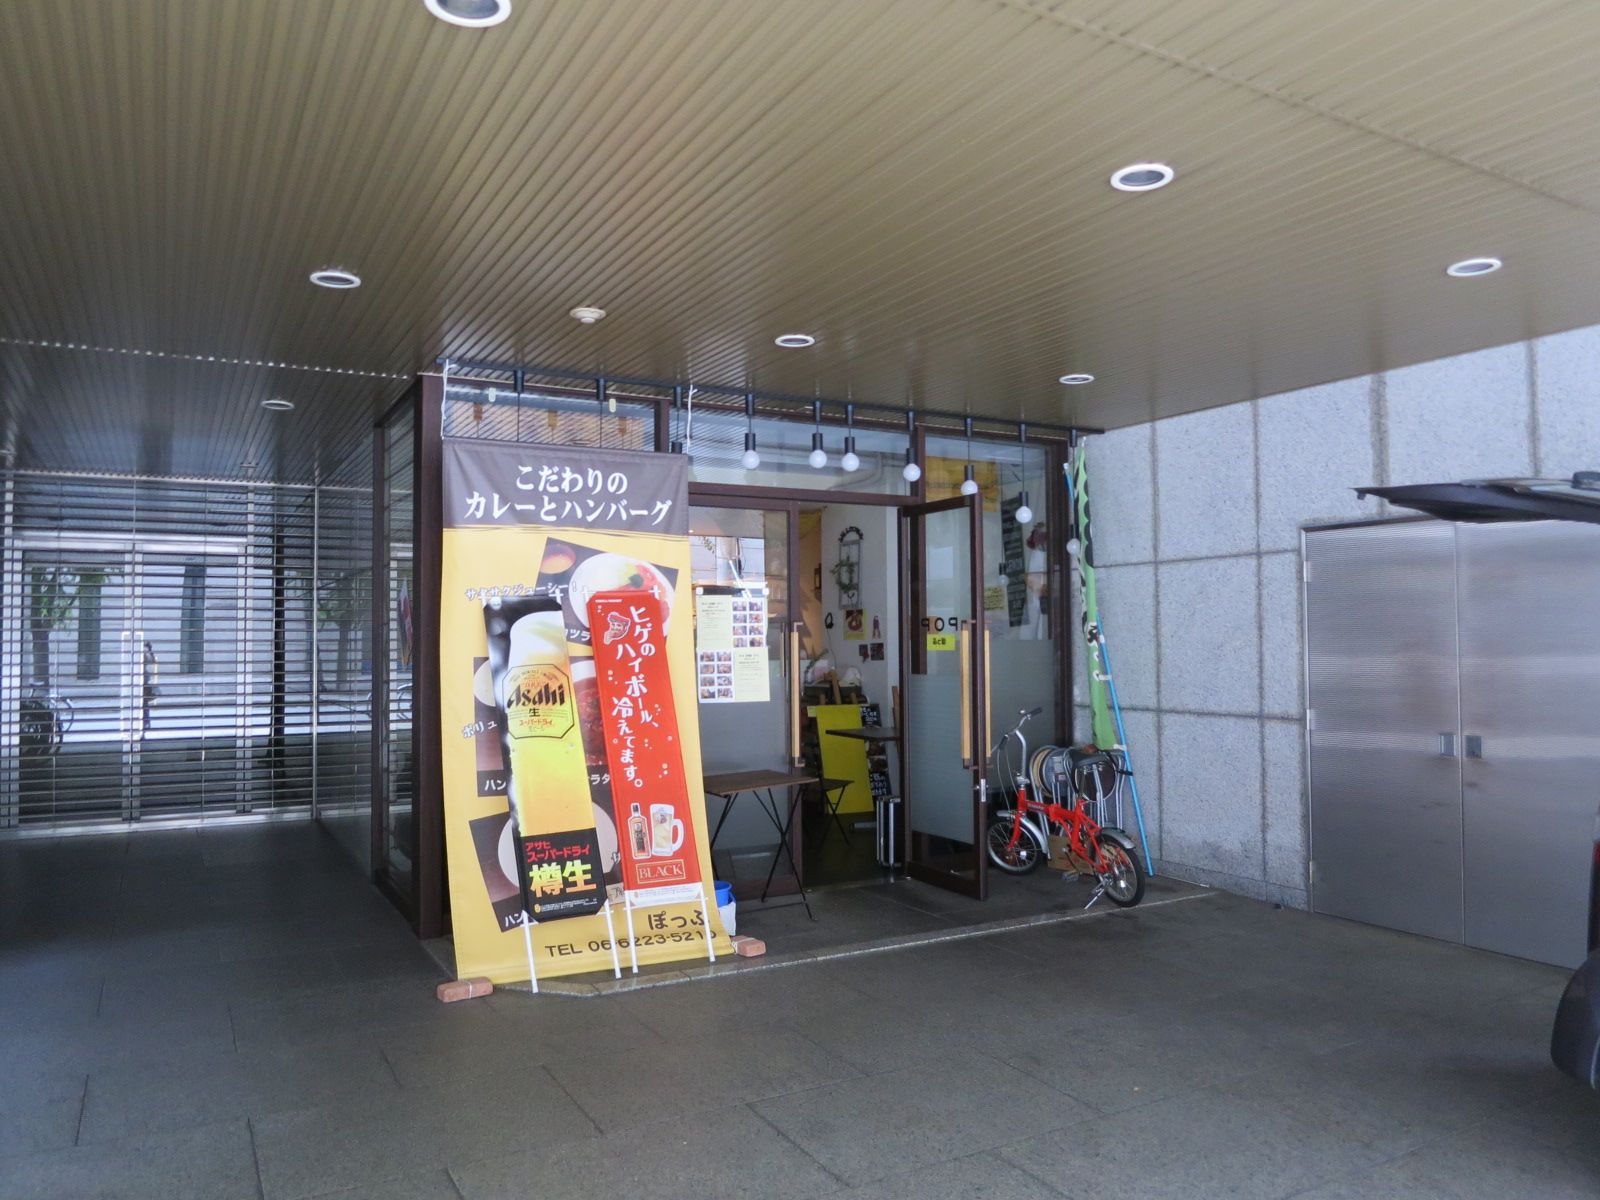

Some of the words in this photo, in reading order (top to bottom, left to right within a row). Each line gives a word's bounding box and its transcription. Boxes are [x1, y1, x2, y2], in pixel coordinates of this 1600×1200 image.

[516, 464, 628, 495] こだわりの
[463, 491, 673, 526] カレーとハンバーグ
[565, 628, 591, 642] ツラ
[629, 605, 656, 657] ヒゲの
[507, 683, 565, 709] Asahi
[528, 707, 541, 718] 生
[611, 696, 643, 788] 冷えてます。
[484, 779, 507, 791] ハン
[587, 772, 610, 785] ラタ
[526, 840, 552, 852] アサヒ
[527, 844, 591, 863] スーパードライ
[529, 859, 597, 898] 樽生
[639, 864, 683, 879] BLACK
[545, 943, 583, 958] TEL
